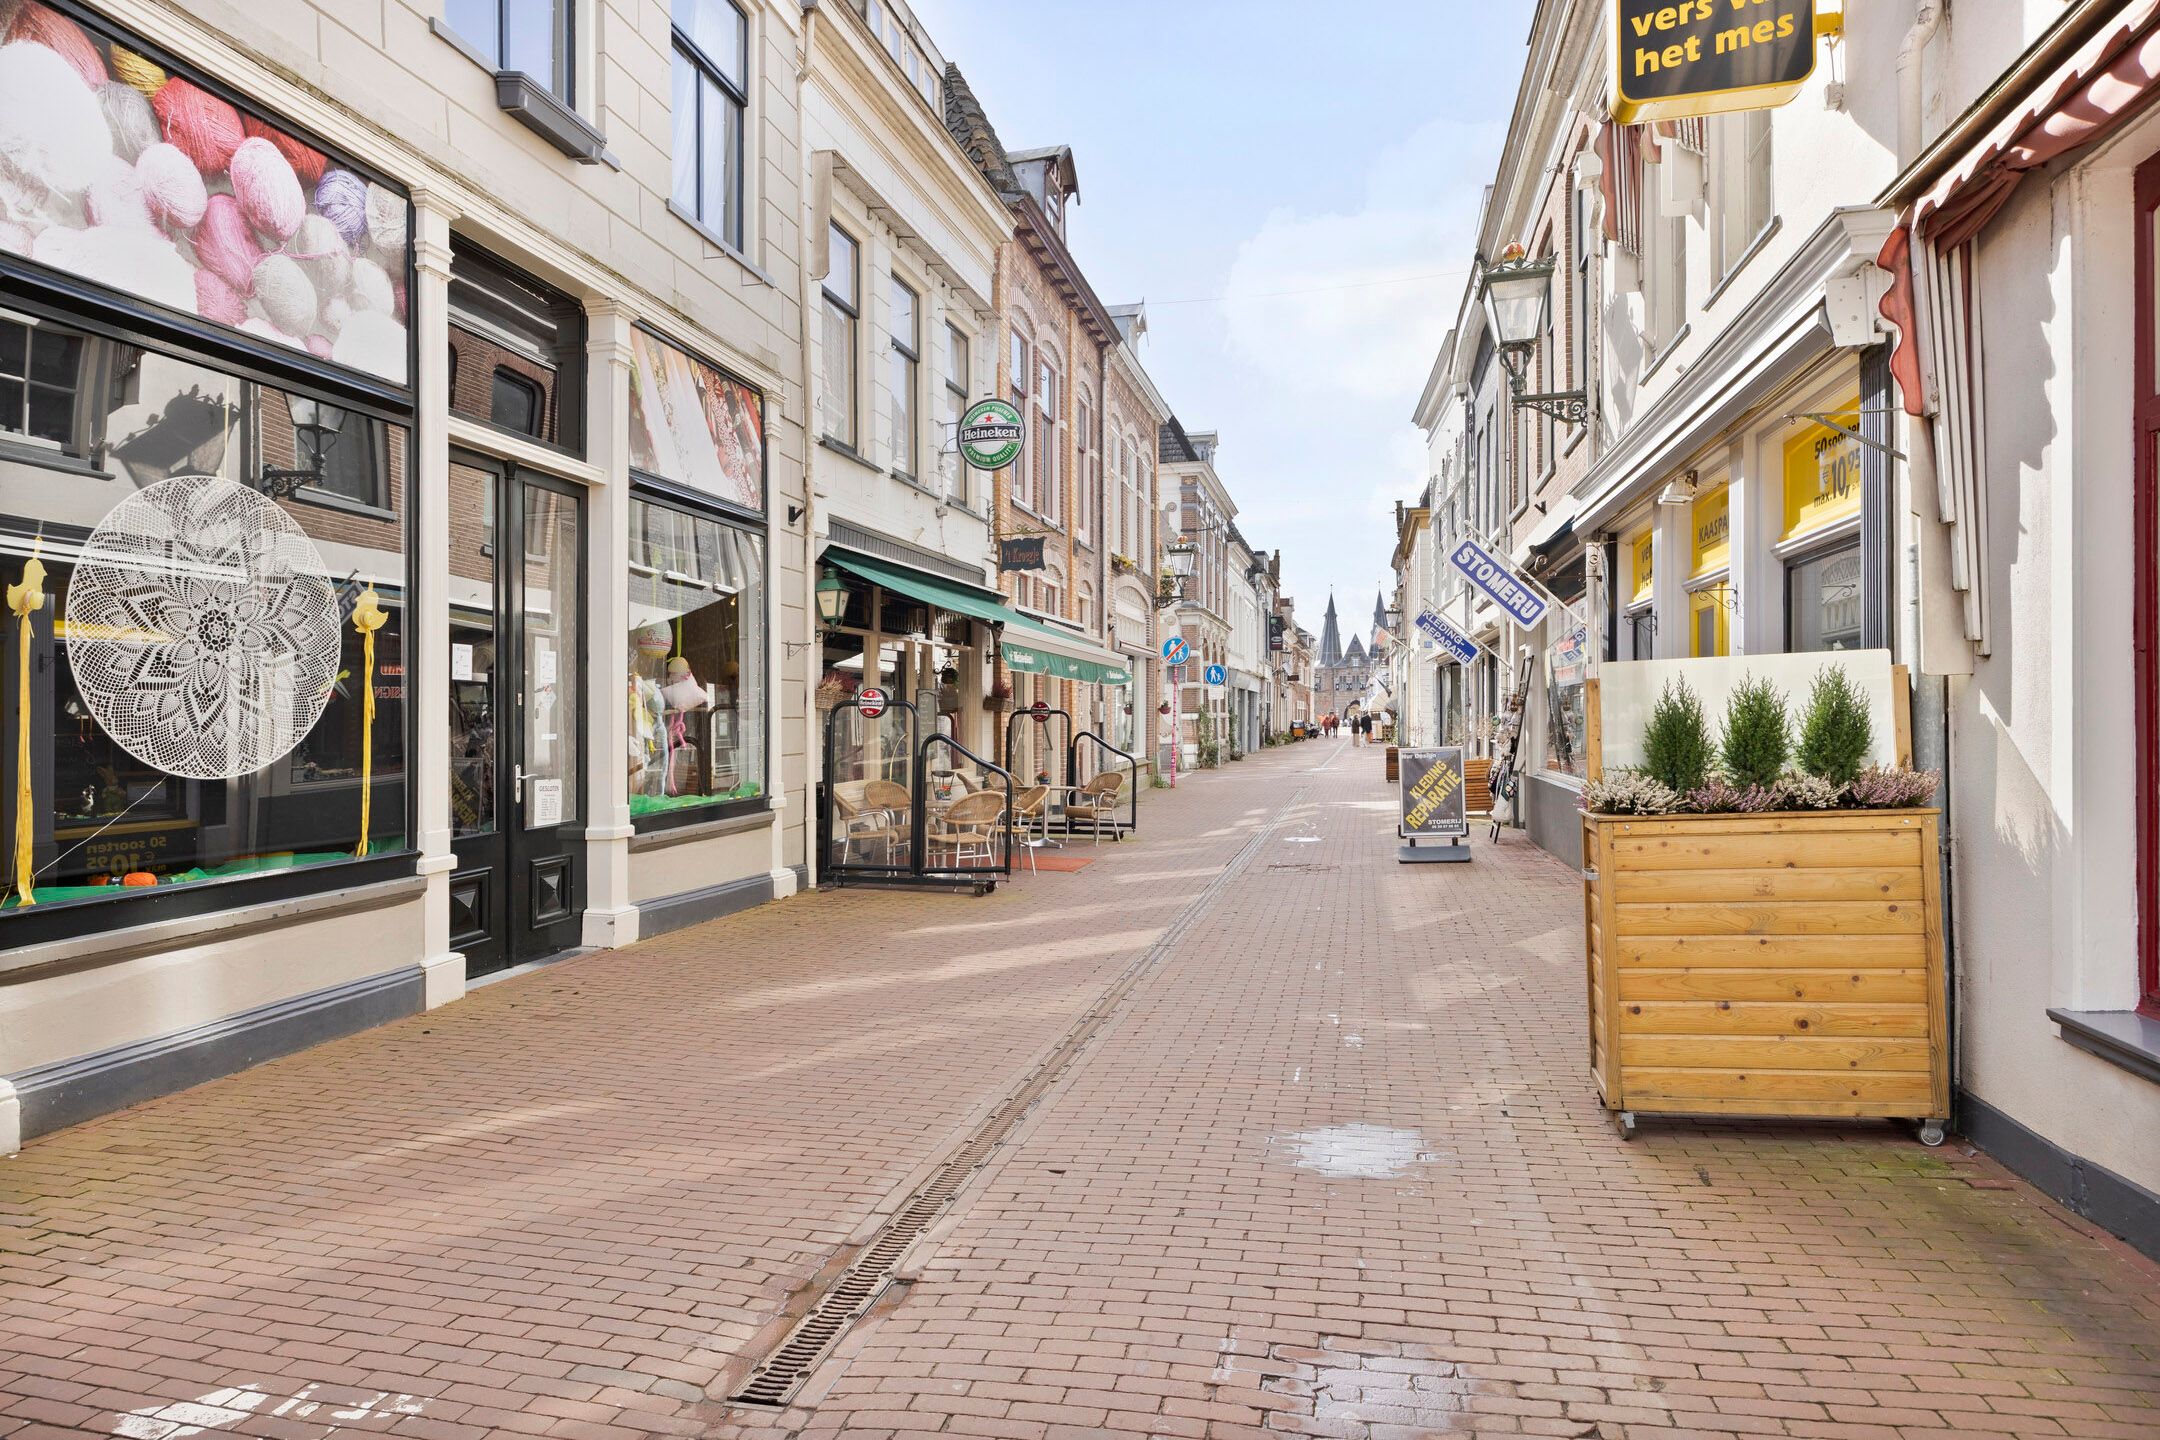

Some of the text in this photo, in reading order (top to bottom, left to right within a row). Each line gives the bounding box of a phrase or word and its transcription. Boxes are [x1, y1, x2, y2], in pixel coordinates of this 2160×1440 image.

[1631, 0, 1713, 37] vers
[1635, 13, 1794, 77] het mes
[964, 427, 1017, 441] Heineken
[1814, 437, 1827, 460] 50
[992, 445, 1014, 462] QUALITY
[1422, 610, 1465, 647] KLEDING-
[1422, 622, 1471, 664] REPARATIE
[1414, 752, 1437, 760] Design
[1409, 760, 1437, 800] KLEDING
[1405, 769, 1461, 830] REPARATIE
[1428, 818, 1462, 826] STOMERIJ
